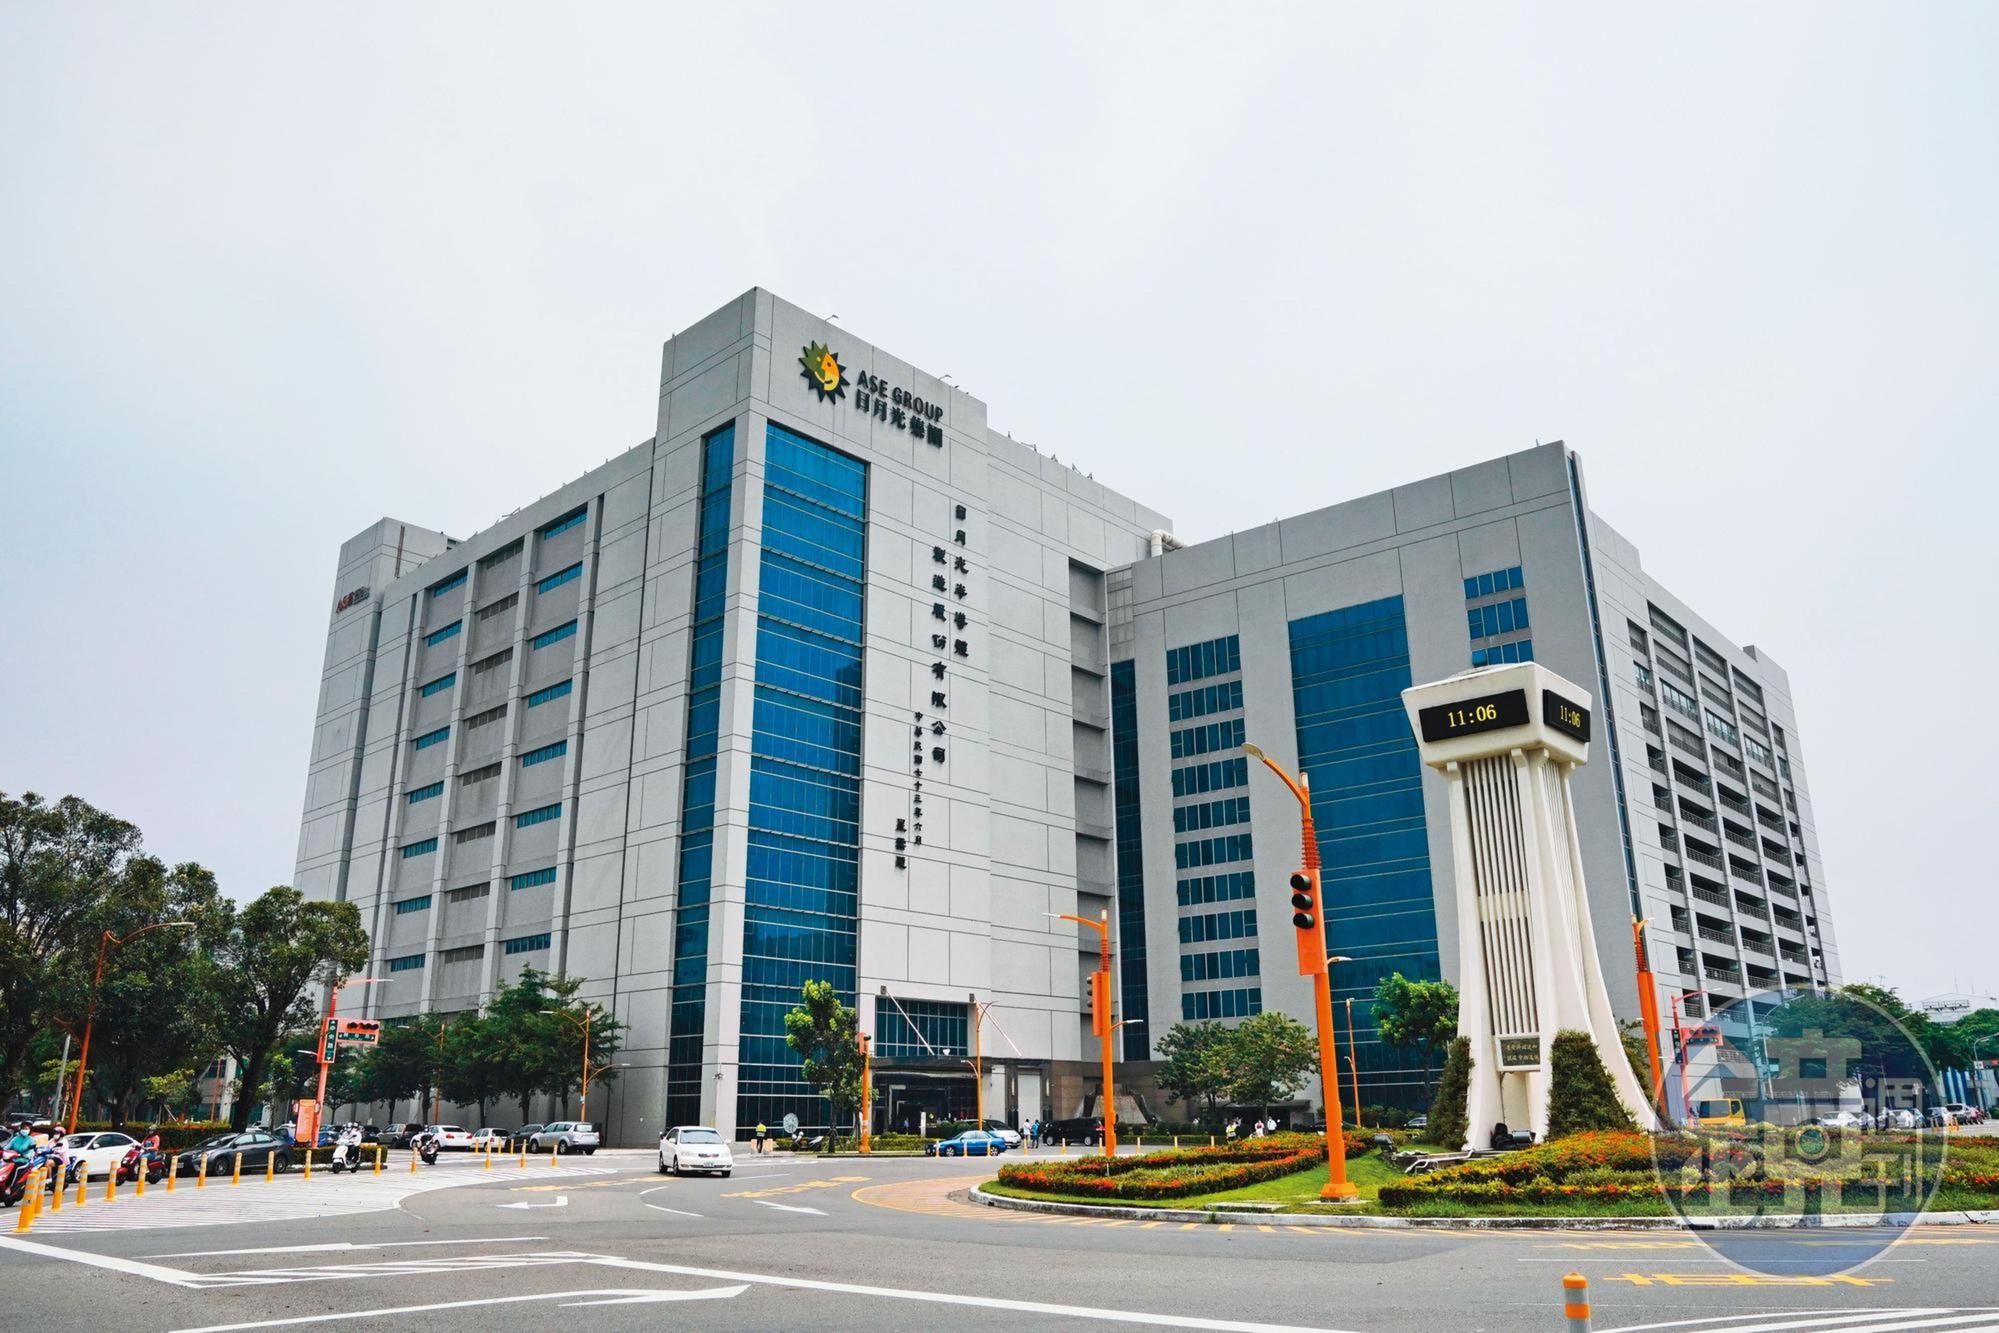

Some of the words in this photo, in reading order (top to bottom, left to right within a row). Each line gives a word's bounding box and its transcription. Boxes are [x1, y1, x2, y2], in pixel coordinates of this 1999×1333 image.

[855, 388, 943, 449] 日月光集團
[856, 370, 889, 399] ASE
[891, 386, 944, 423] GROUP
[954, 504, 969, 658] 日月光半導體
[1447, 704, 1497, 728] 11:06
[1560, 705, 1581, 728] 11:06
